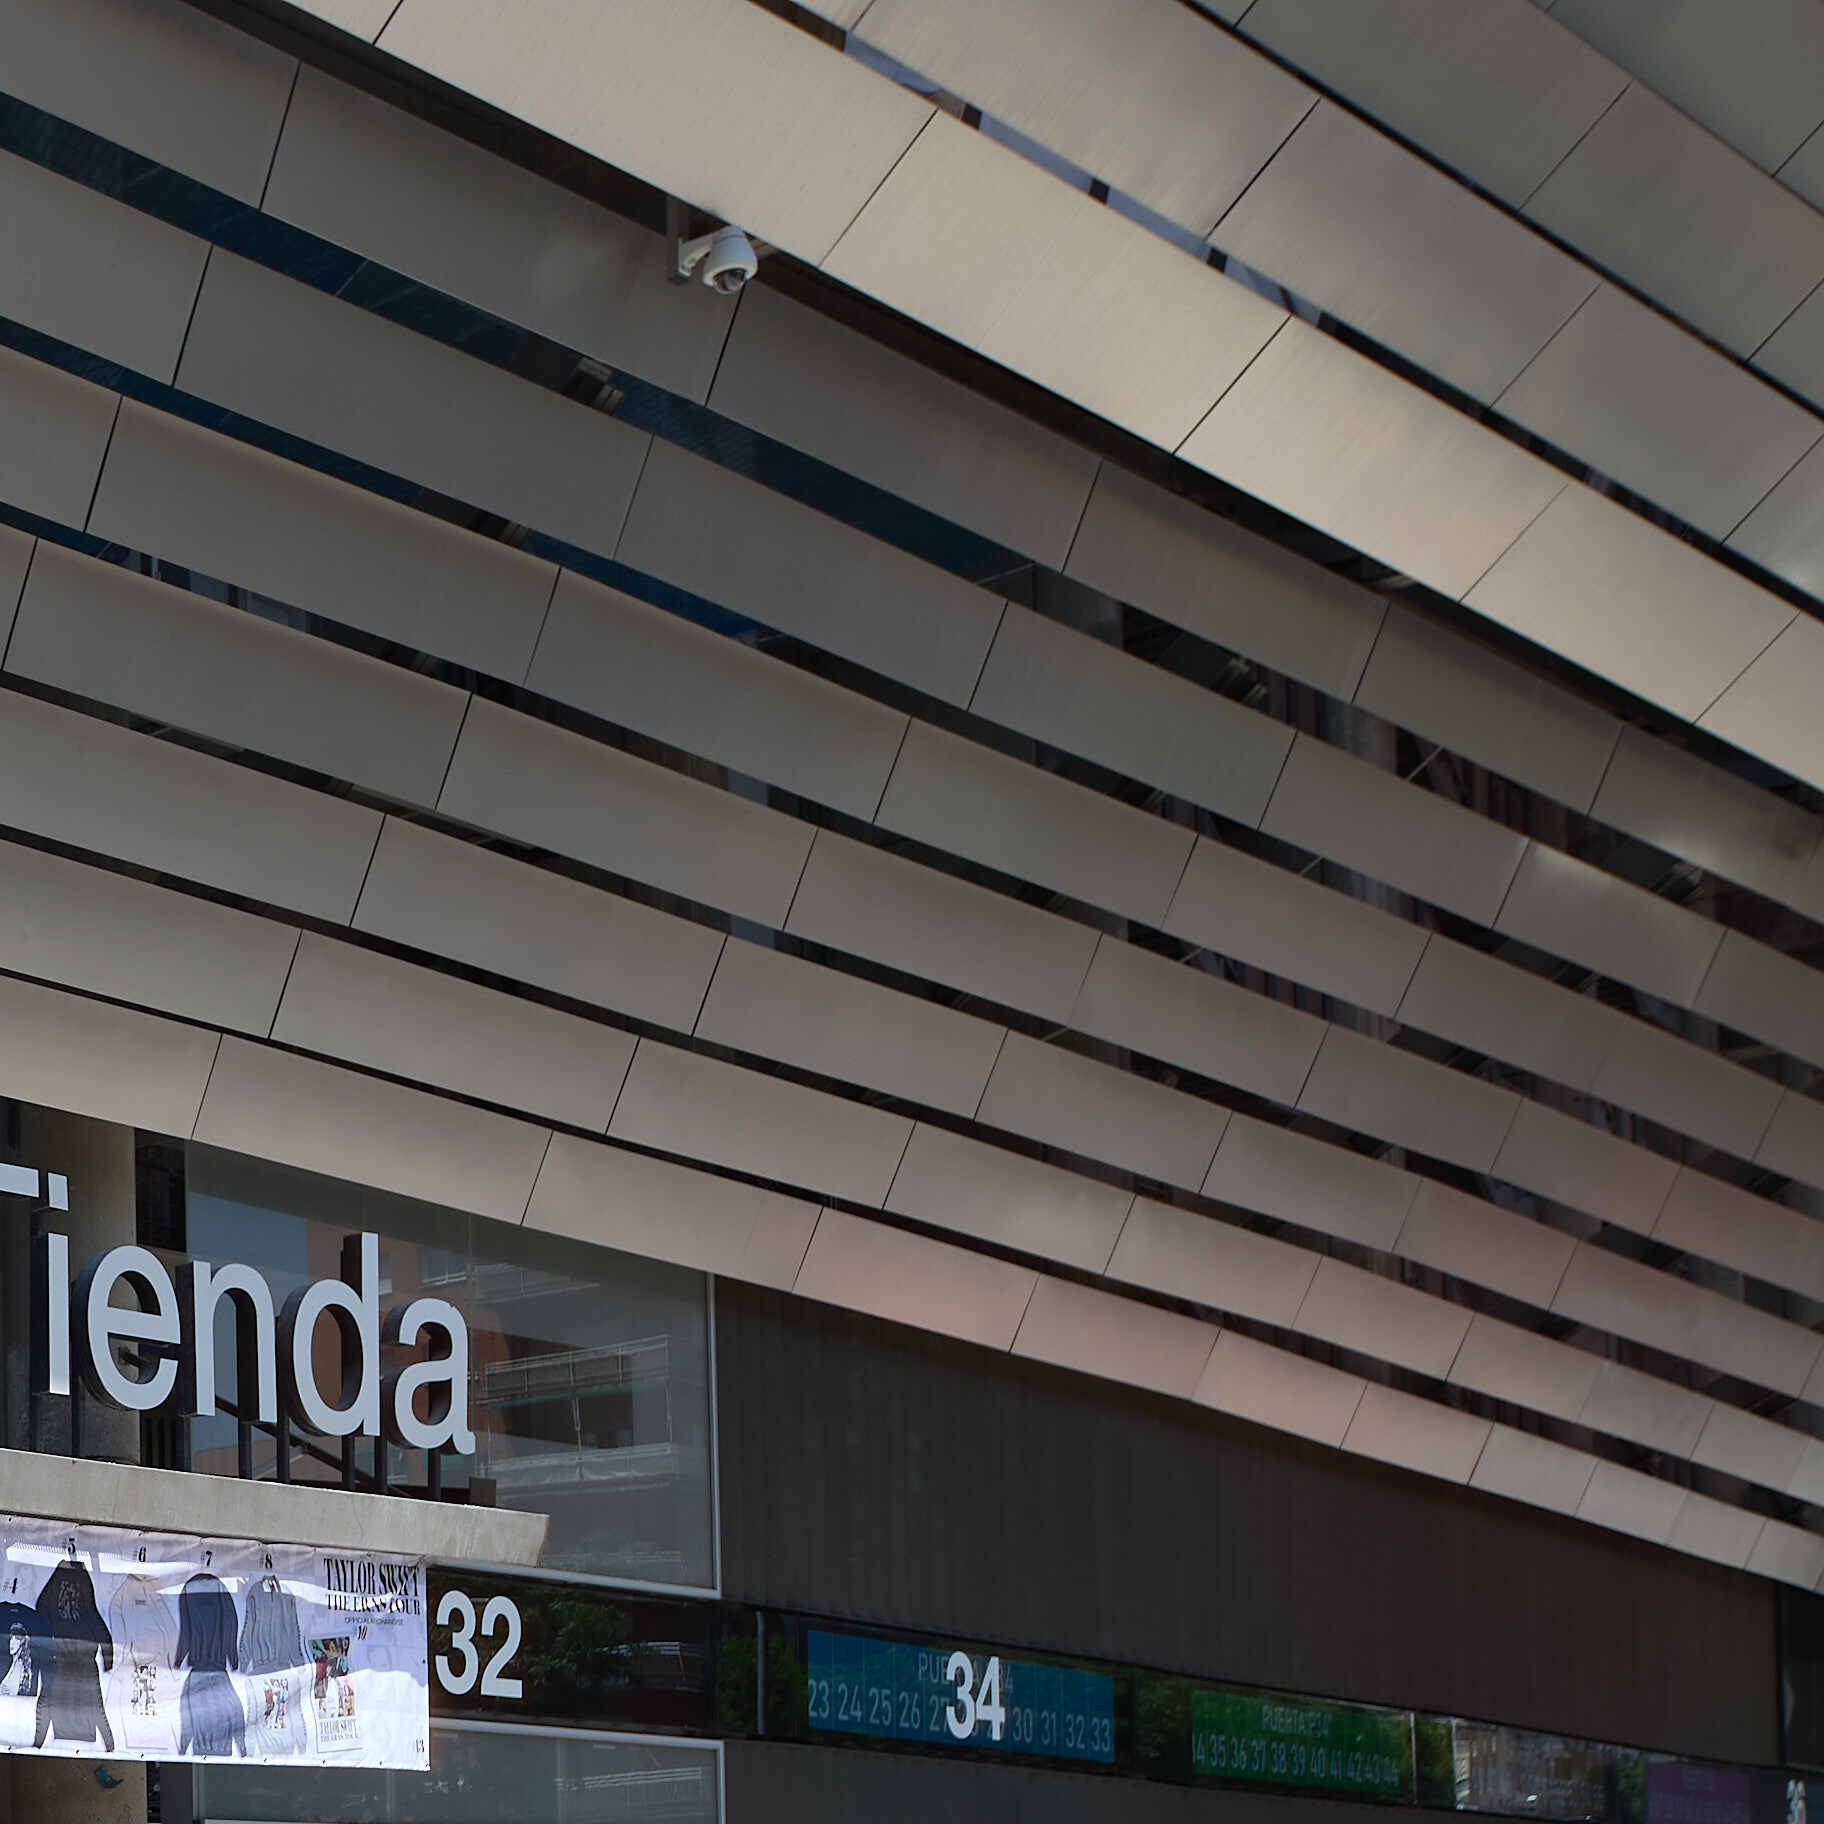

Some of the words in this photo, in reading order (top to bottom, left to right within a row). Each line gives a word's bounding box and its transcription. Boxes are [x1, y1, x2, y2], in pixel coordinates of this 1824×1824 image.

[323, 1557, 377, 1596] TAYLOR
[379, 1564, 421, 1597] SWIFT
[325, 1593, 350, 1611] THE
[388, 1597, 421, 1616] TOUR
[434, 1589, 524, 1699] 32
[807, 1680, 830, 1718] 23
[838, 1684, 863, 1723] 24
[869, 1688, 893, 1726] 25
[898, 1692, 921, 1729] 26
[1012, 1708, 1033, 1744] 30
[1040, 1710, 1057, 1747] 31
[1065, 1714, 1086, 1750] 32
[1091, 1717, 1111, 1753] 33
[946, 1651, 1007, 1741] 34
[1262, 1703, 1305, 1734] PUERTA
[1209, 1734, 1226, 1768] 35
[1230, 1735, 1247, 1769] 36
[1252, 1738, 1267, 1772] 37
[1271, 1742, 1288, 1774] 38
[1292, 1743, 1307, 1776] 39
[1311, 1747, 1328, 1778] 40
